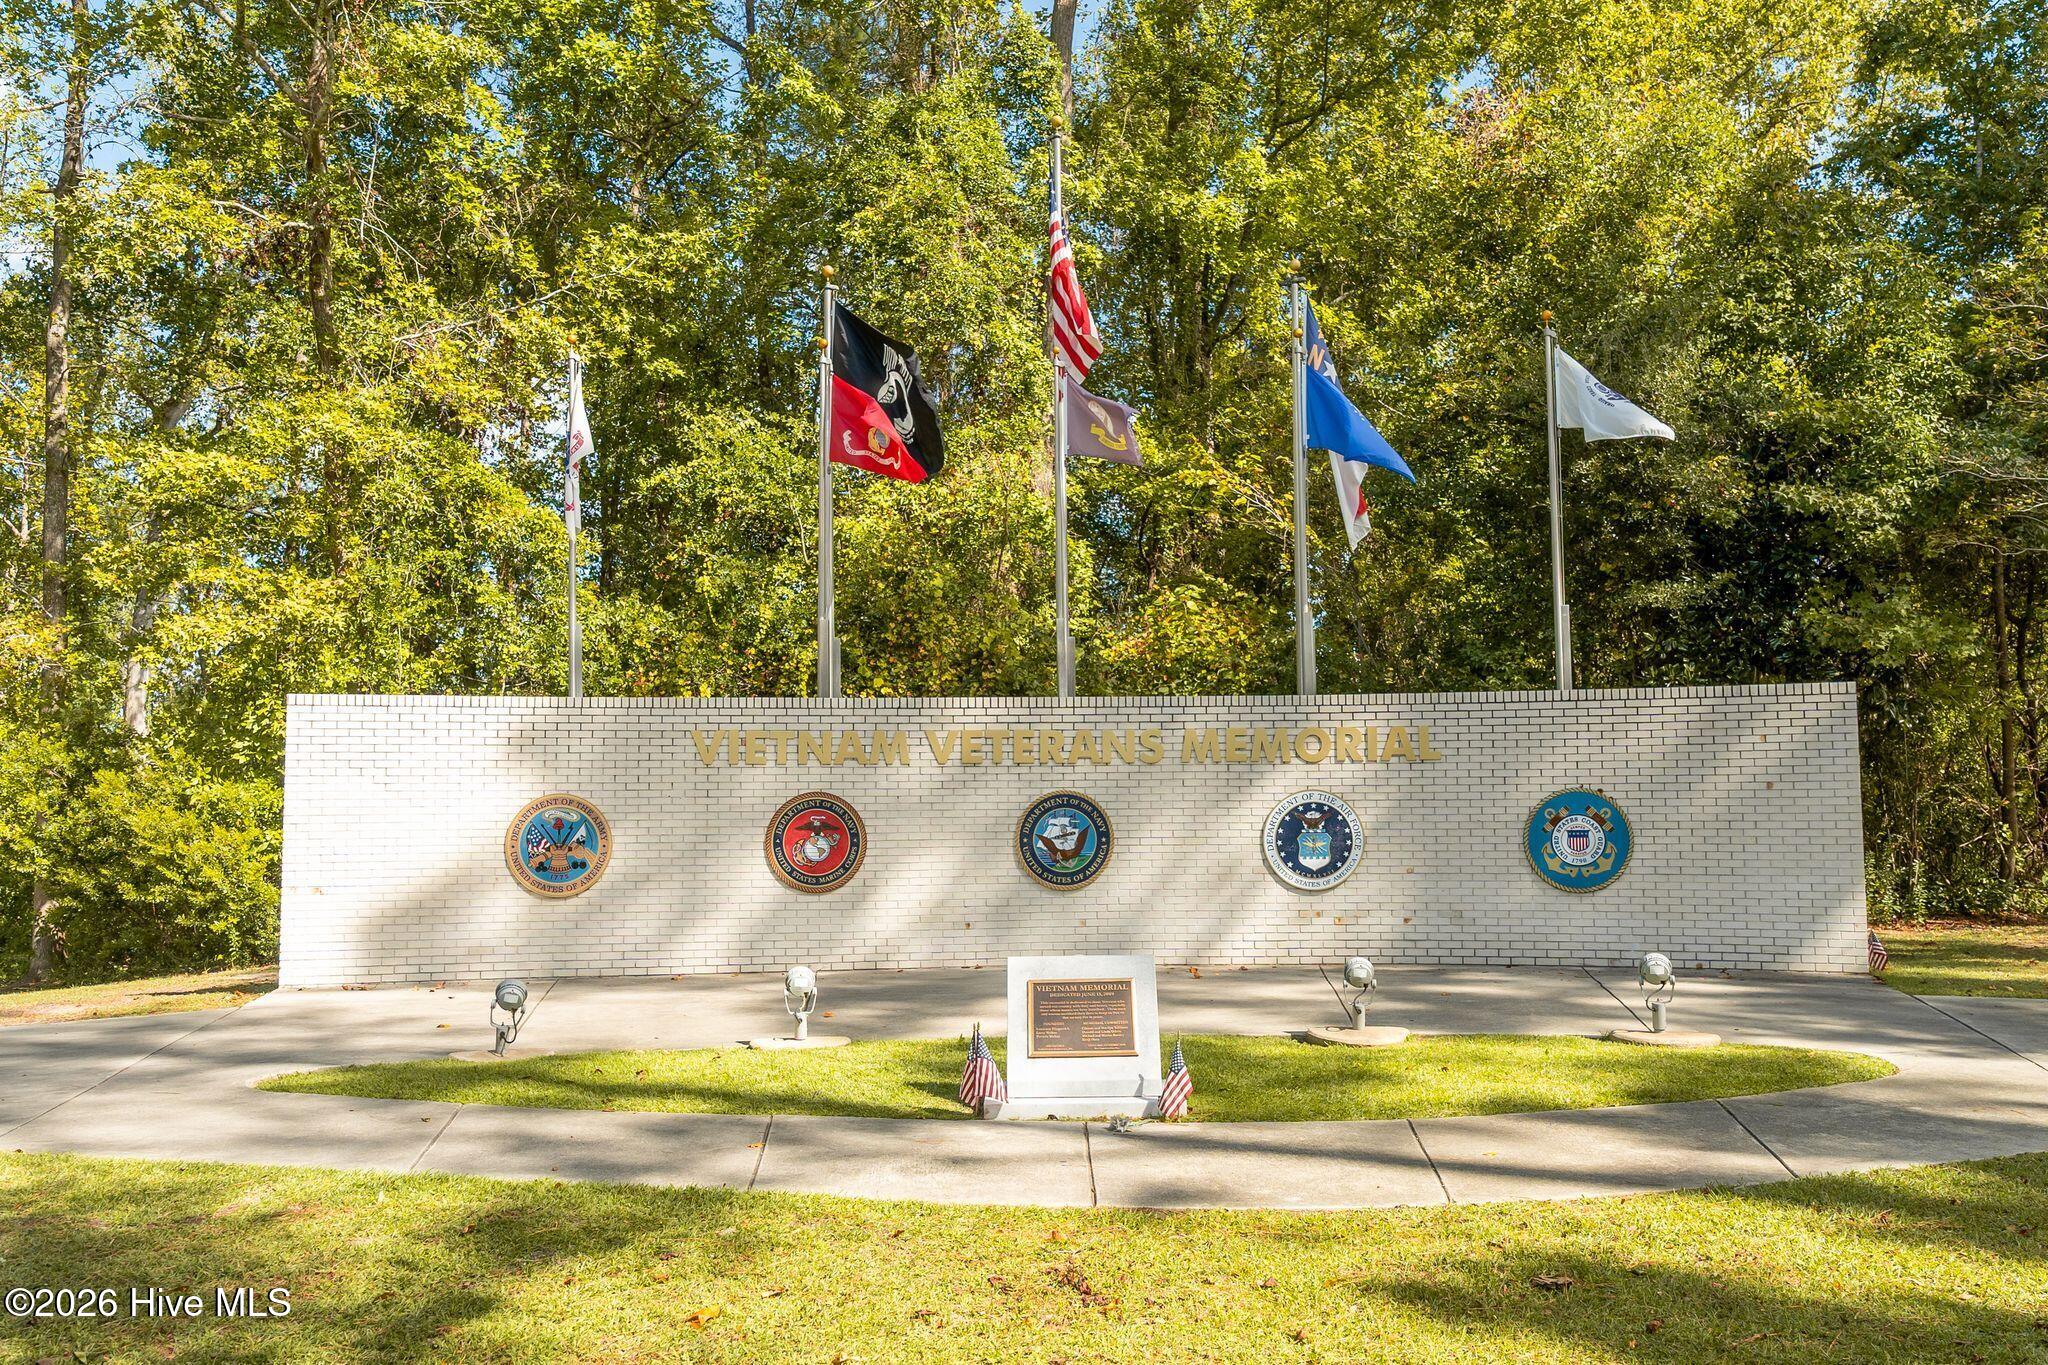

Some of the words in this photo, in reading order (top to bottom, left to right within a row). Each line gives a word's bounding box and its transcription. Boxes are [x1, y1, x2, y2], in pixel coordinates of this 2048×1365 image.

[1308, 344, 1325, 370] N
[691, 728, 911, 766] VIETNAM
[925, 727, 1165, 766] VETERANS
[1181, 725, 1442, 764] MEMORIAL
[511, 798, 558, 841] DEPARTMENT
[561, 797, 573, 805] OF
[576, 802, 592, 817] THE
[592, 816, 608, 841] ARMY
[776, 800, 820, 835] DEPARTMENT
[832, 803, 844, 814] THE
[844, 813, 857, 834] NAVY
[1023, 797, 1069, 834] DEPARTMENT
[1080, 801, 1092, 811] THE
[1091, 811, 1107, 832] NAVY
[1266, 795, 1299, 852] DEPARTMENT
[1302, 793, 1315, 801] OF
[1318, 793, 1338, 804] THE
[1337, 803, 1352, 818] AIR
[1349, 818, 1363, 851] FORCE
[1556, 817, 1579, 833] STATES
[1581, 817, 1601, 834] COAST
[775, 846, 791, 873] UNITED
[792, 871, 816, 883] STATES
[819, 868, 846, 884] MARINE
[845, 846, 858, 868] CORPS
[1022, 846, 1042, 874] UNITED
[1042, 872, 1072, 883] STATES
[1086, 843, 1107, 877] AMERICA
[1553, 836, 1568, 860] UNITED
[1590, 837, 1604, 859] GUARD
[511, 851, 531, 882] UNITED
[531, 880, 564, 893] STATES
[580, 851, 608, 887] AMERICA
[1273, 859, 1293, 881] UNITED
[1295, 878, 1321, 888] STATES
[1333, 858, 1358, 881] AMERICA
[1036, 984, 1077, 992] VIETNAM
[1079, 983, 1129, 991] MEMORIAL
